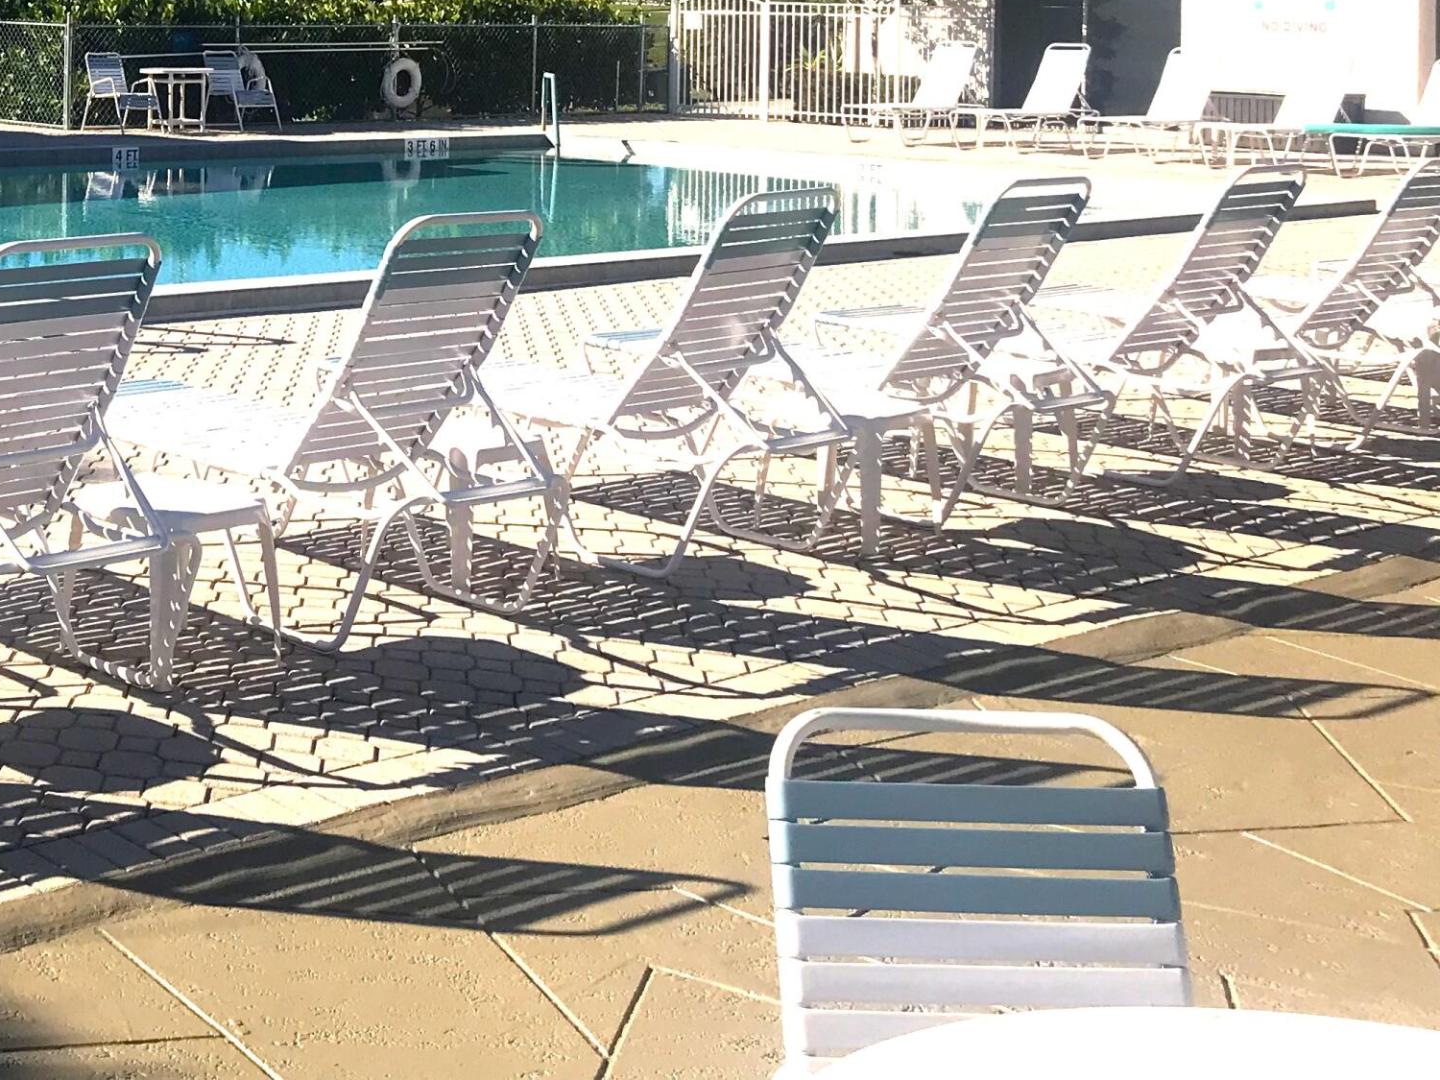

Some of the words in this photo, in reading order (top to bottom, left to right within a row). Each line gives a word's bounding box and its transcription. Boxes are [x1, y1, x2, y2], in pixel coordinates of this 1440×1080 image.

[407, 140, 414, 151] 3
[430, 140, 436, 151] 6
[115, 149, 122, 161] 4
